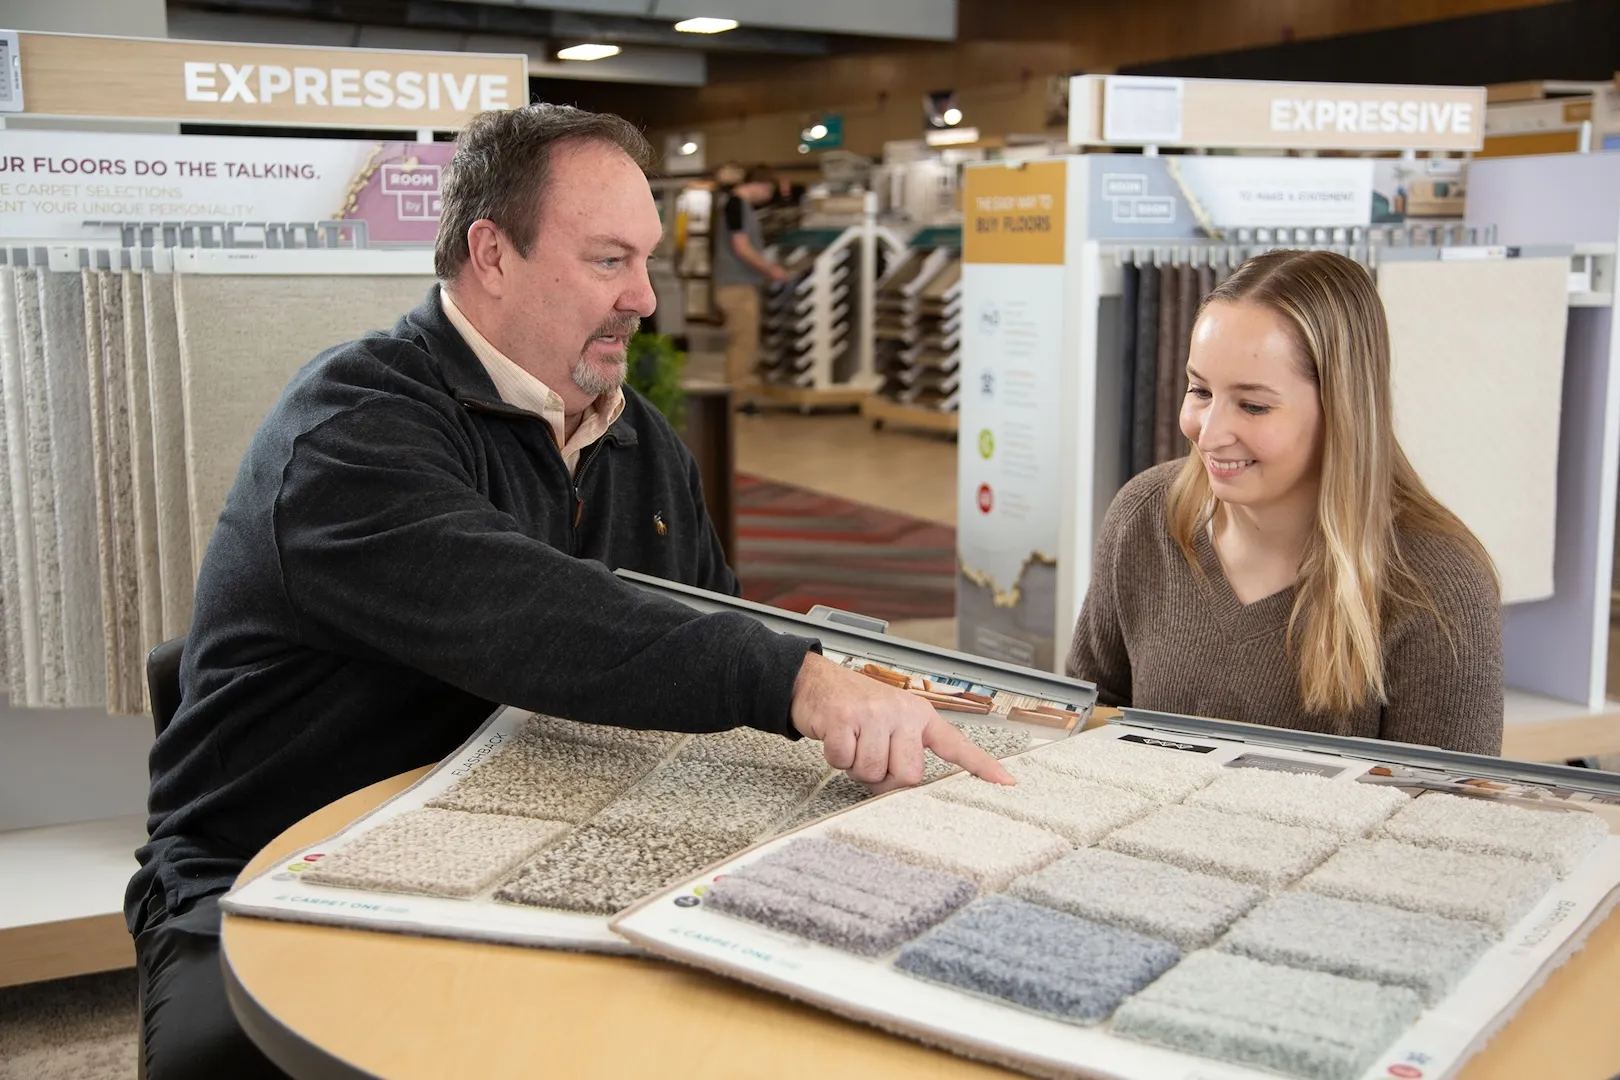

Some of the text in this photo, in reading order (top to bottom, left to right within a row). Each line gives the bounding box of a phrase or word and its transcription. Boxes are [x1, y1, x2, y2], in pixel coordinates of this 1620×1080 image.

[184, 61, 509, 111] EXPRESSIVE
[1270, 98, 1473, 134] EXPRESSIVE
[33, 157, 126, 175] FLOORS
[134, 160, 167, 176] DO
[175, 161, 217, 177] THE
[224, 162, 321, 180] TALKING.
[15, 183, 80, 198] CARPET
[85, 184, 183, 199] SELECTIONS
[31, 200, 78, 214] YOUR
[83, 202, 144, 216] UNIQUE
[451, 732, 507, 776] FLASHBACK
